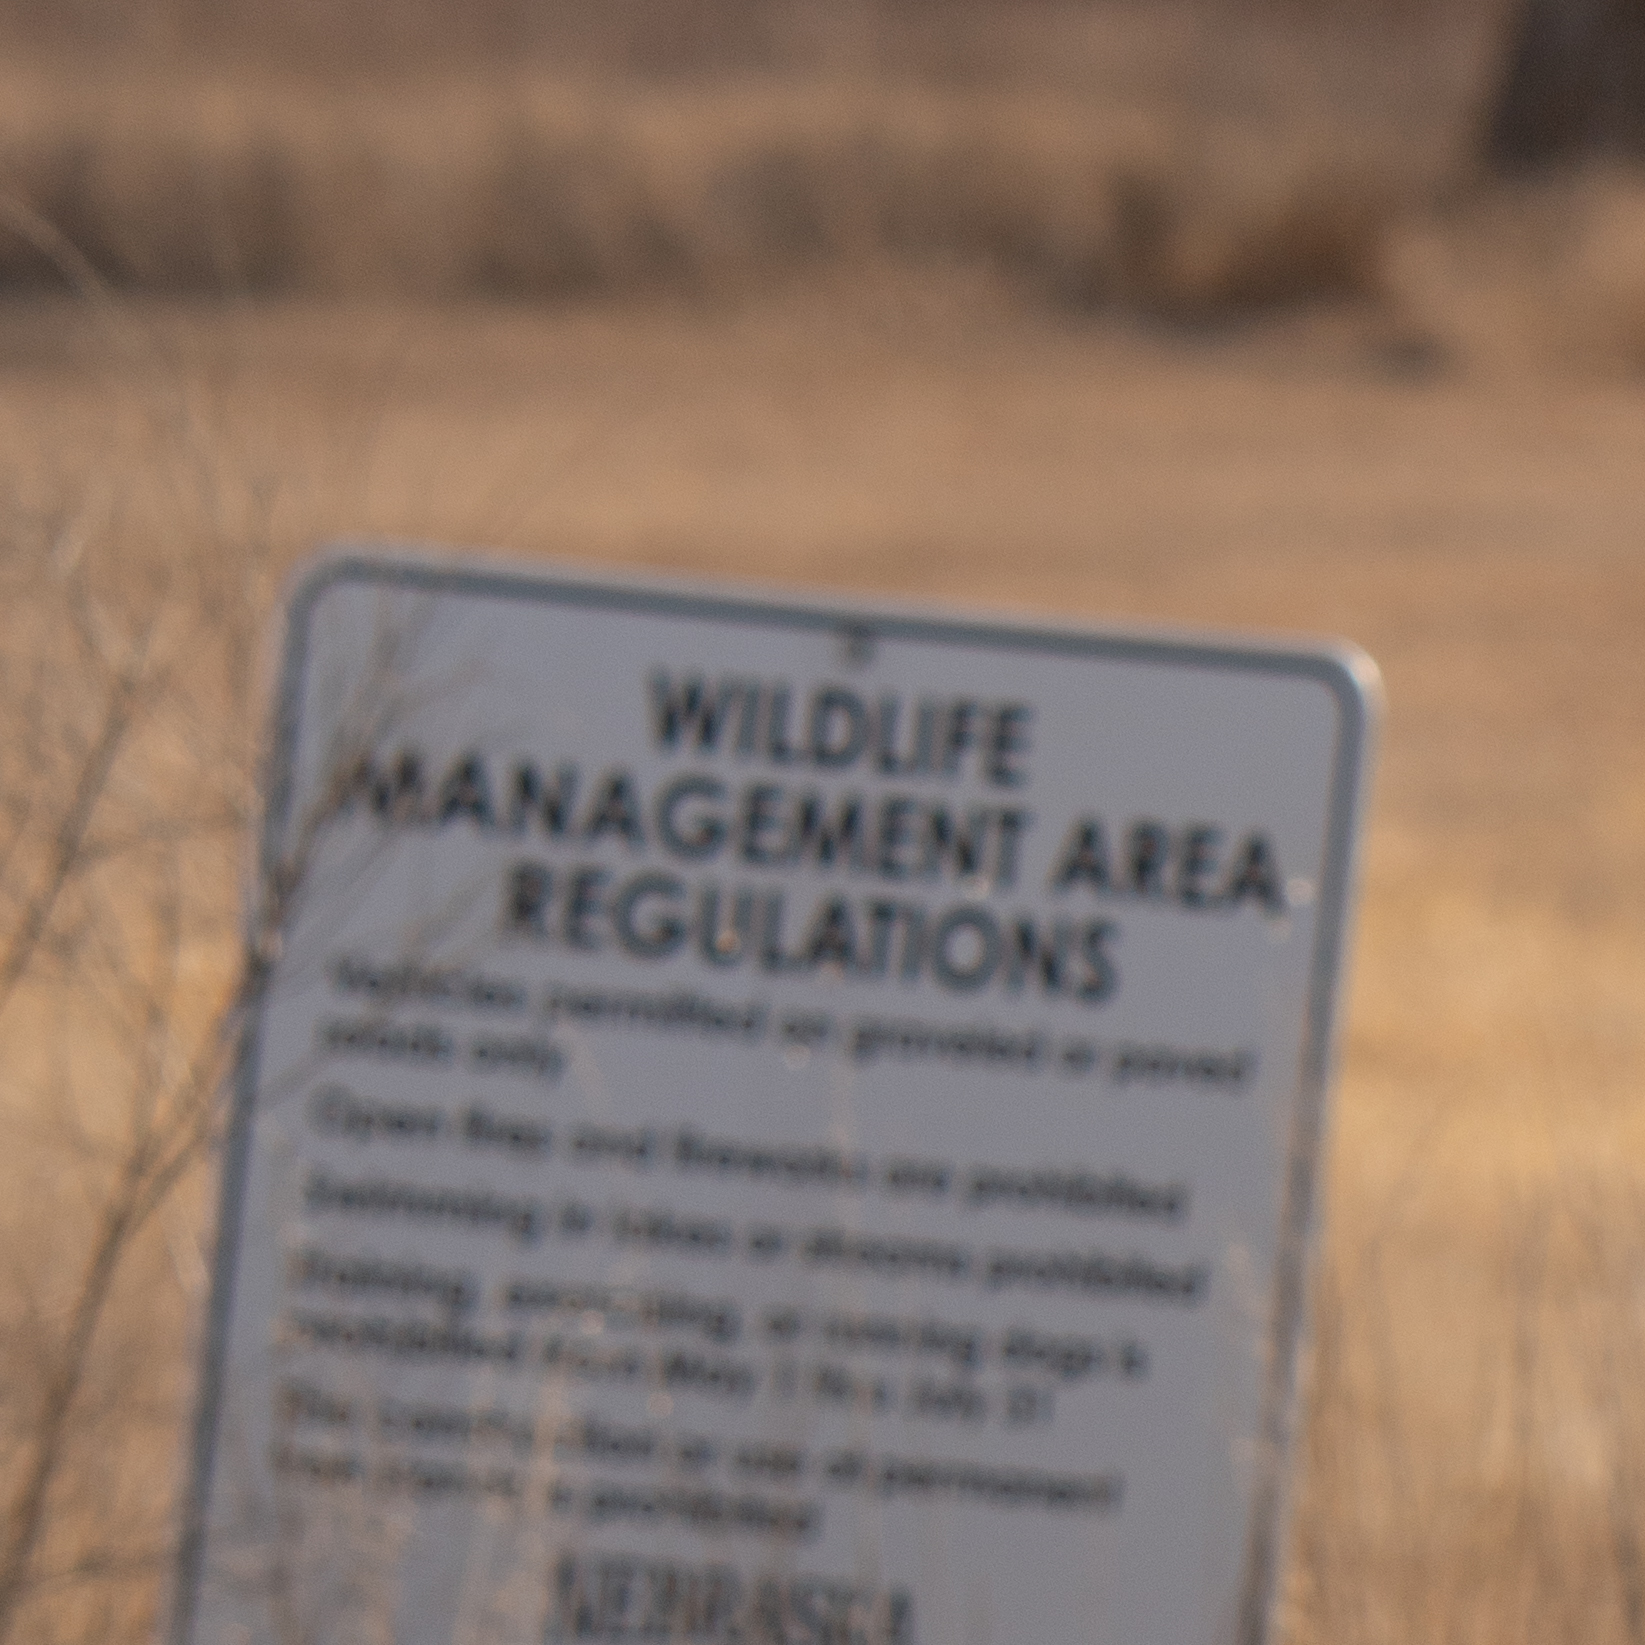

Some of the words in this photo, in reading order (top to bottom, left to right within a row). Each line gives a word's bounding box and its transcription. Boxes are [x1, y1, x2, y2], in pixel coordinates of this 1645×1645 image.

[647, 671, 1032, 781] WILDLIFE
[348, 745, 1026, 885] MANAGEMENT
[1059, 817, 1289, 911] AREA
[507, 865, 1120, 998] REGULATIONS
